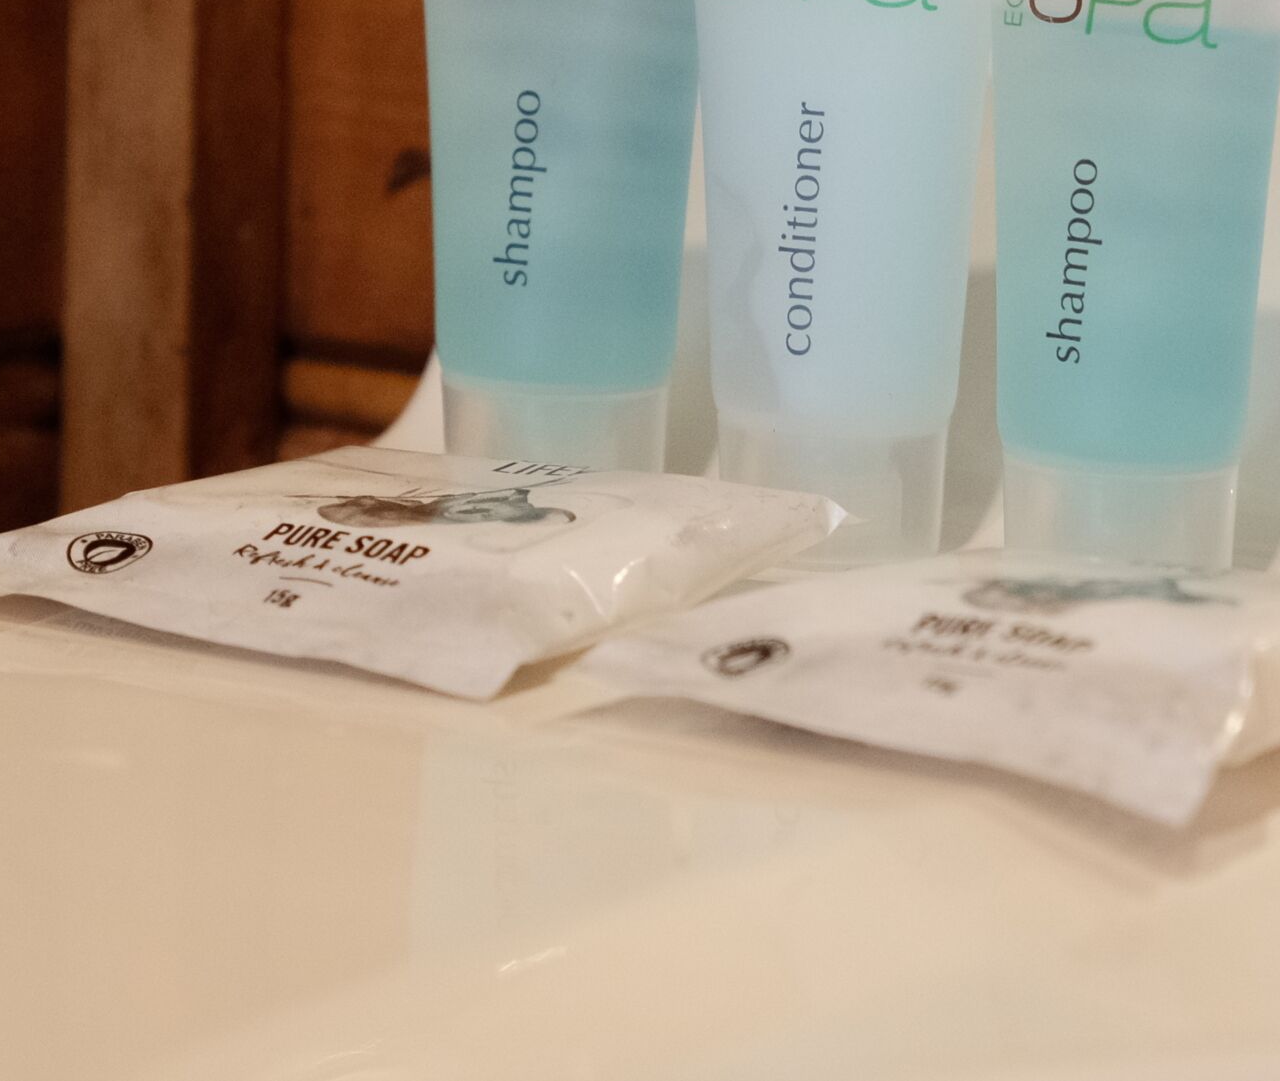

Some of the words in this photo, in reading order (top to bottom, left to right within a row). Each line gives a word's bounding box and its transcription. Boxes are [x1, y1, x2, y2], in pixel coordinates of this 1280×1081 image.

[493, 89, 547, 287] shampoo
[778, 101, 825, 356] conditioner
[1045, 158, 1102, 364] shampoo
[262, 522, 350, 550] PURE
[344, 535, 431, 565] SOAP
